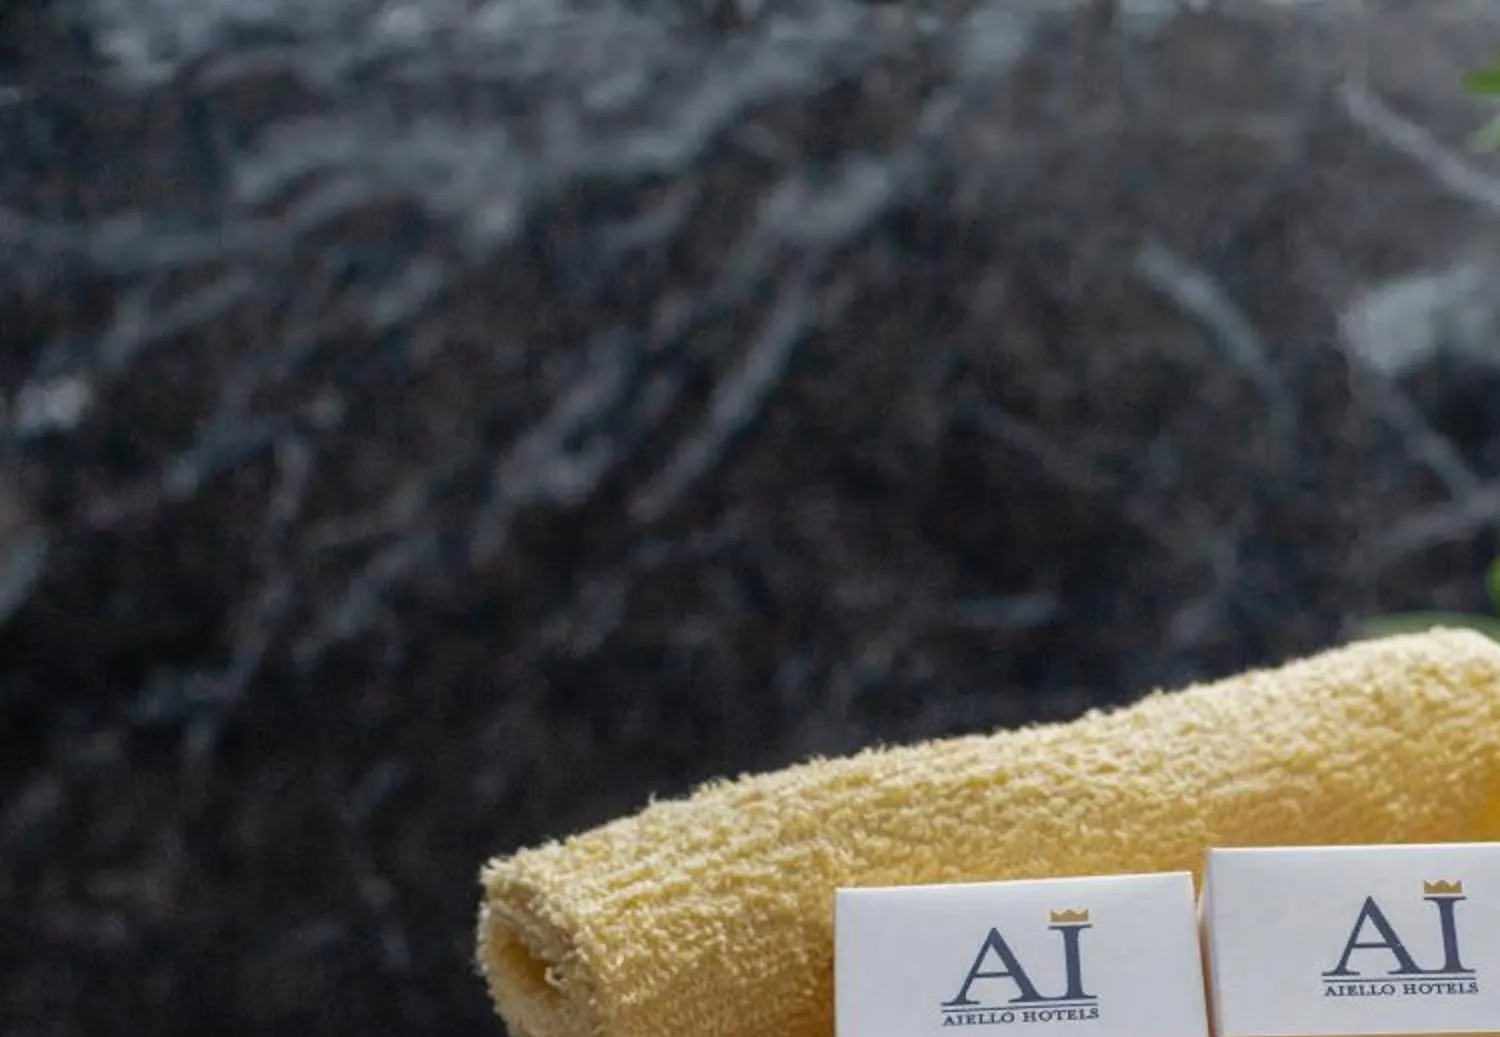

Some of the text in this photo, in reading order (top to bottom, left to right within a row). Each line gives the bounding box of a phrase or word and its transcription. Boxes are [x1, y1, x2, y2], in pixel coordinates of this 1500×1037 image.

[1322, 895, 1476, 977] AI
[941, 924, 1098, 1006] AI
[1323, 981, 1479, 998] AIELLO HOTELS
[942, 1007, 1100, 1027] AIELLO HOTELS
